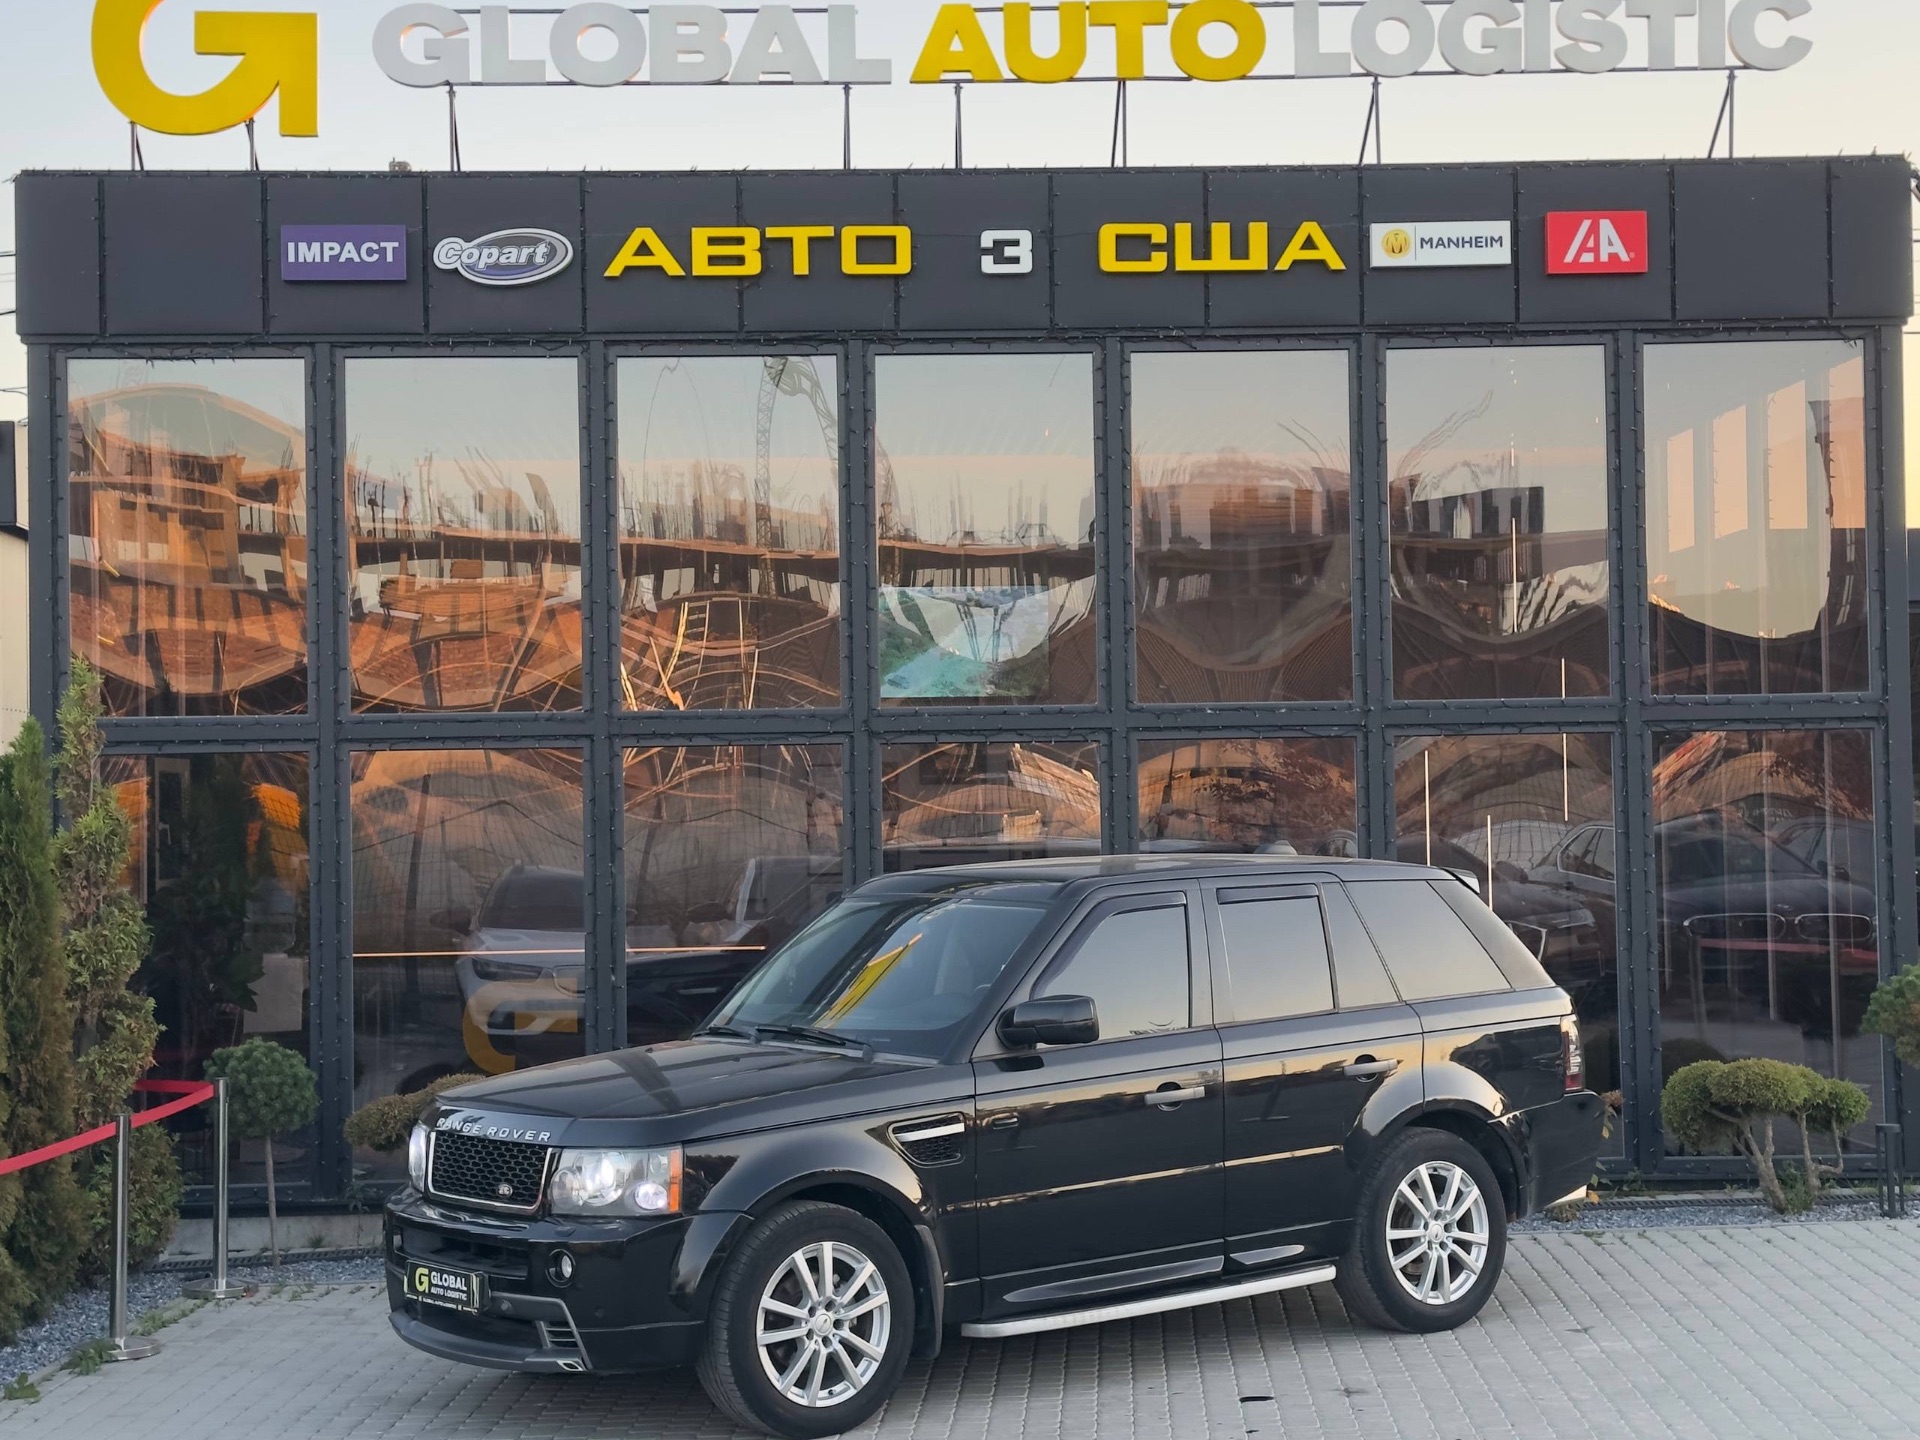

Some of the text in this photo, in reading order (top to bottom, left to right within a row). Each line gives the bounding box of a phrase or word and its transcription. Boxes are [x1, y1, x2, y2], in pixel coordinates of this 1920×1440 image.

[372, 0, 1813, 88] GLOBAL AUTO LOGISTIC
[287, 241, 399, 263] IMPACT
[603, 225, 912, 277] АВТО
[1098, 221, 1347, 273] США
[1420, 236, 1503, 250] MANHEIM
[437, 240, 551, 271] Copart
[436, 1117, 551, 1142] RANGE ROVER
[430, 1271, 467, 1290] GLOBAL
[430, 1286, 467, 1301] AUTO LOGISTIC
